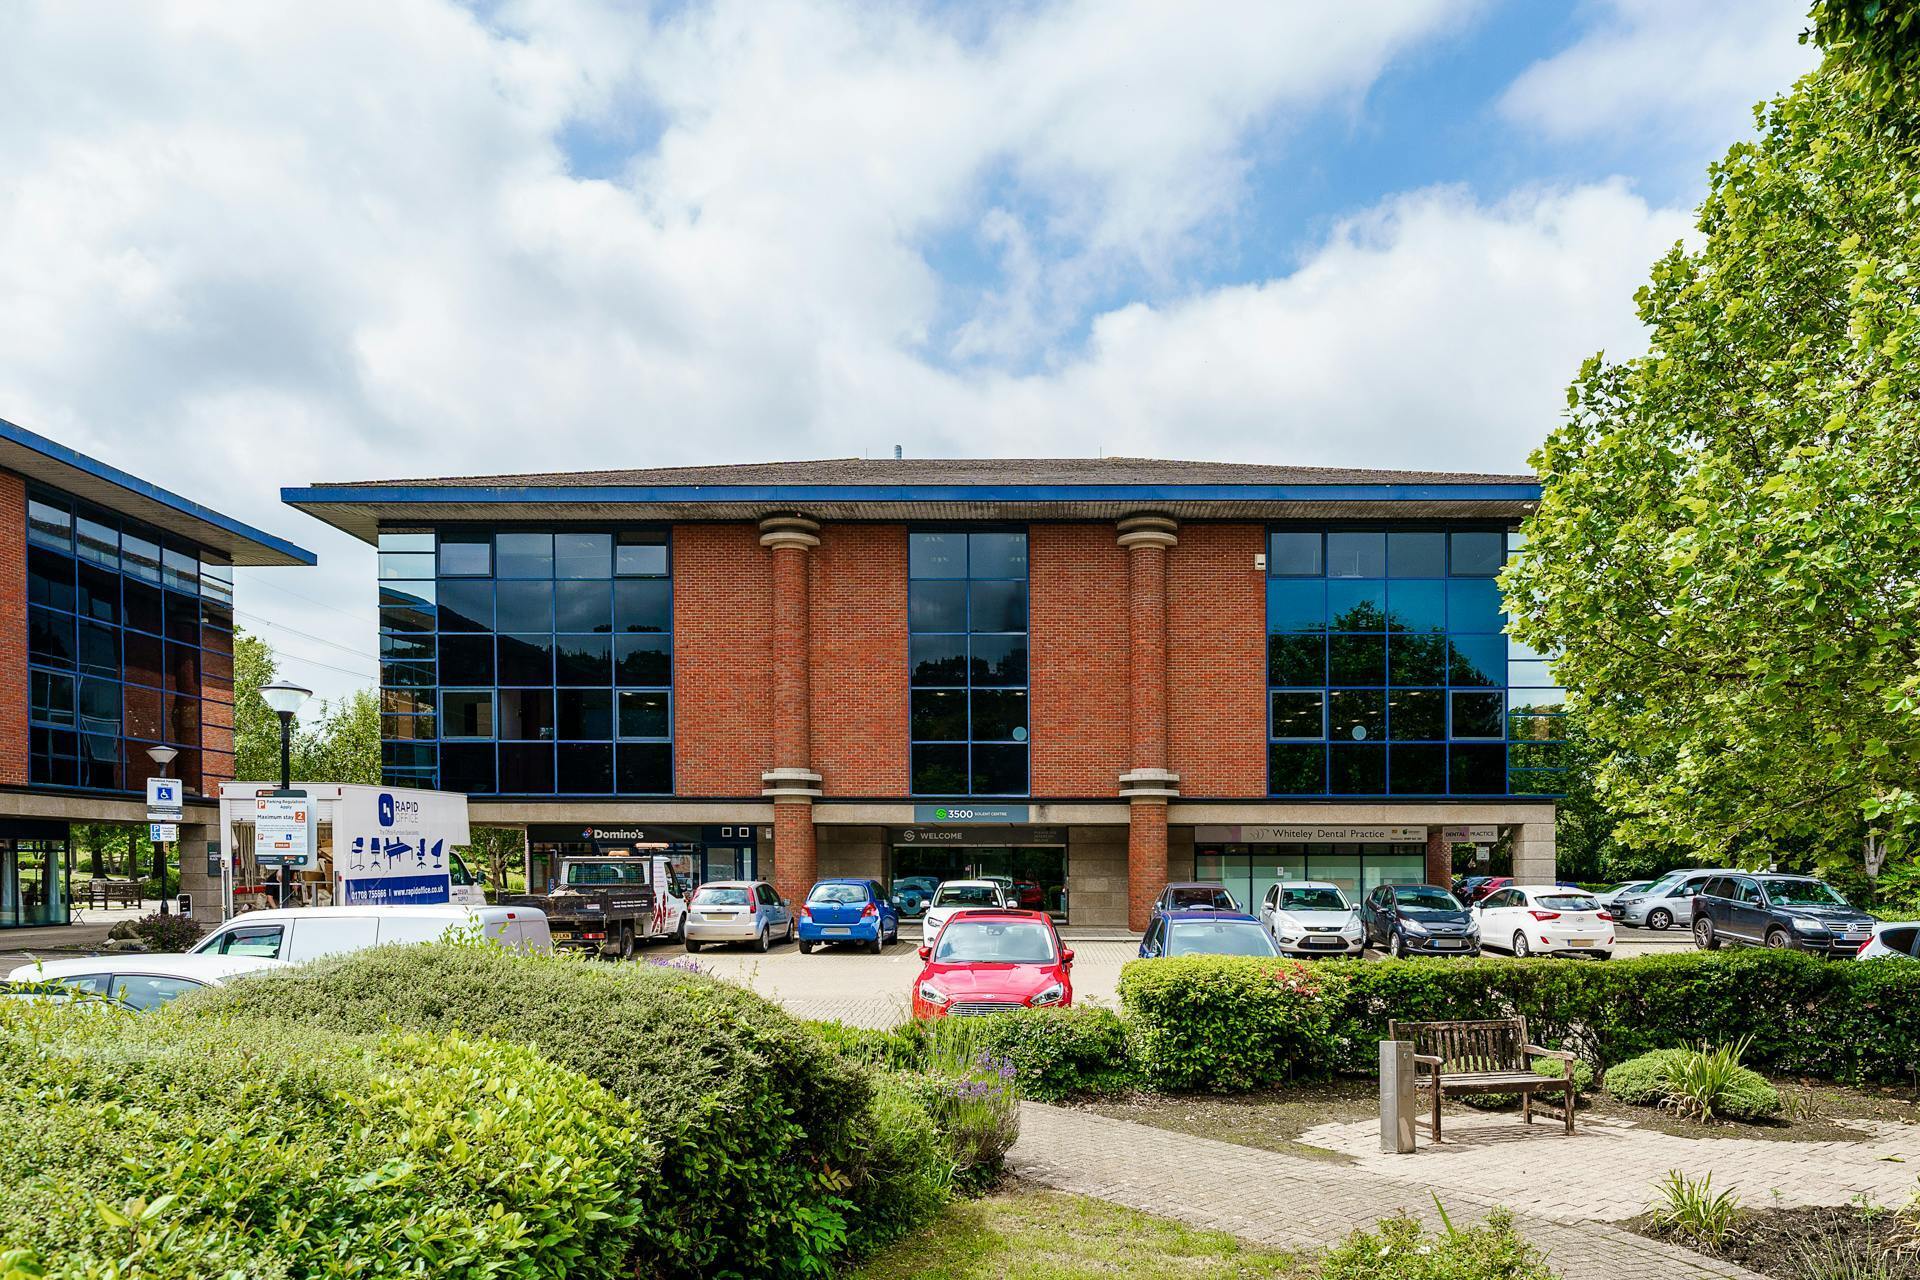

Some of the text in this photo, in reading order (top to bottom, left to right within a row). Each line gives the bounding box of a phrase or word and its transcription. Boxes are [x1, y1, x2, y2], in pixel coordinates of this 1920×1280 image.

[396, 801, 418, 812] RAPID
[396, 813, 418, 823] OFFICE
[948, 810, 973, 818] 3500
[594, 829, 644, 839] Domino's
[1273, 829, 1312, 839] Whiteley
[1318, 829, 1346, 838] Dental
[1351, 829, 1384, 838] Practice
[352, 890, 367, 900] 01708
[368, 889, 387, 898] 755666
[393, 885, 444, 897] www.rapidoffice.co.uk
